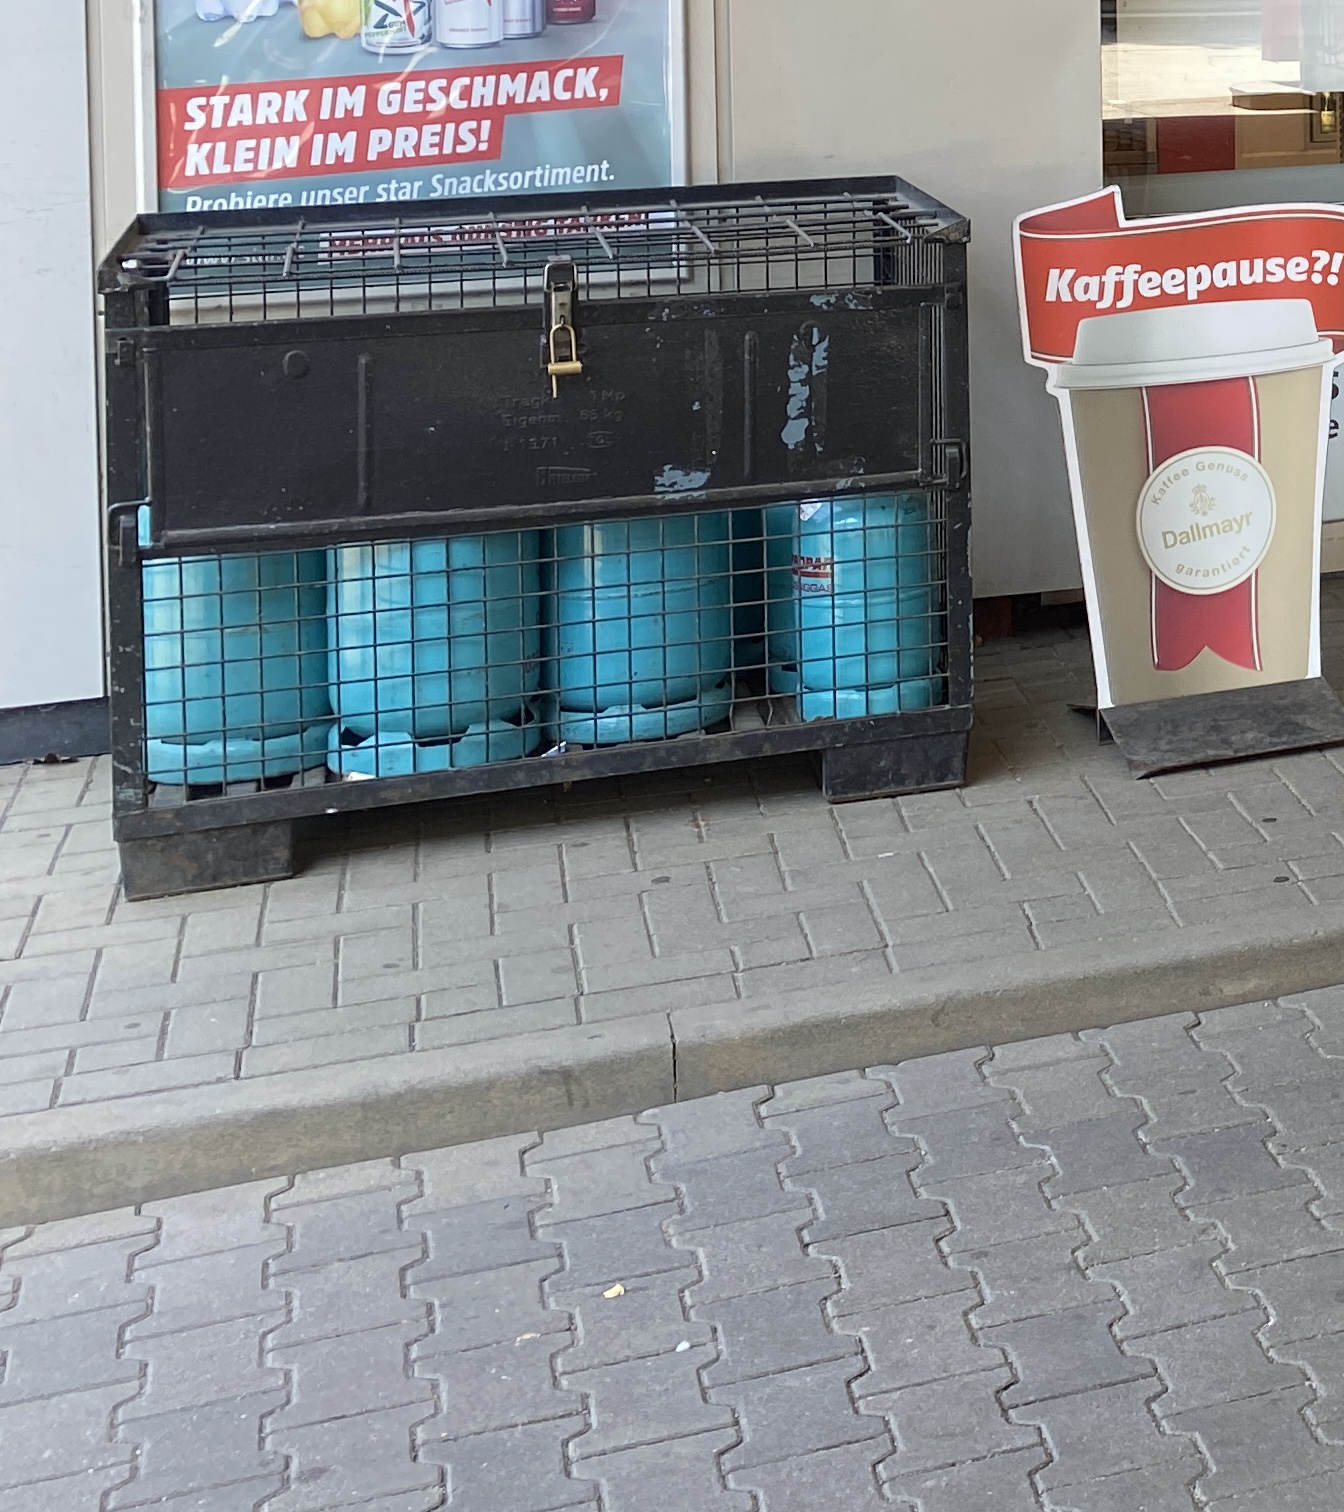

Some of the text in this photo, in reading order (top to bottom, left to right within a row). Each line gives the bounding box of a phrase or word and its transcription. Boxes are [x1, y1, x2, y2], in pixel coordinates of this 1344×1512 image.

[184, 65, 609, 131] STARK IM GESCHMACK,
[184, 120, 491, 177] KLEIN IM PREIS!
[300, 186, 367, 207] unser
[376, 177, 423, 204] star
[429, 159, 615, 198] Snacksortiment.
[1045, 250, 1344, 308] Kaffeepause?!
[1151, 461, 1248, 505] Kaffee Genuss
[1162, 512, 1252, 549] Dallmayr
[1175, 545, 1251, 578] garantiert
